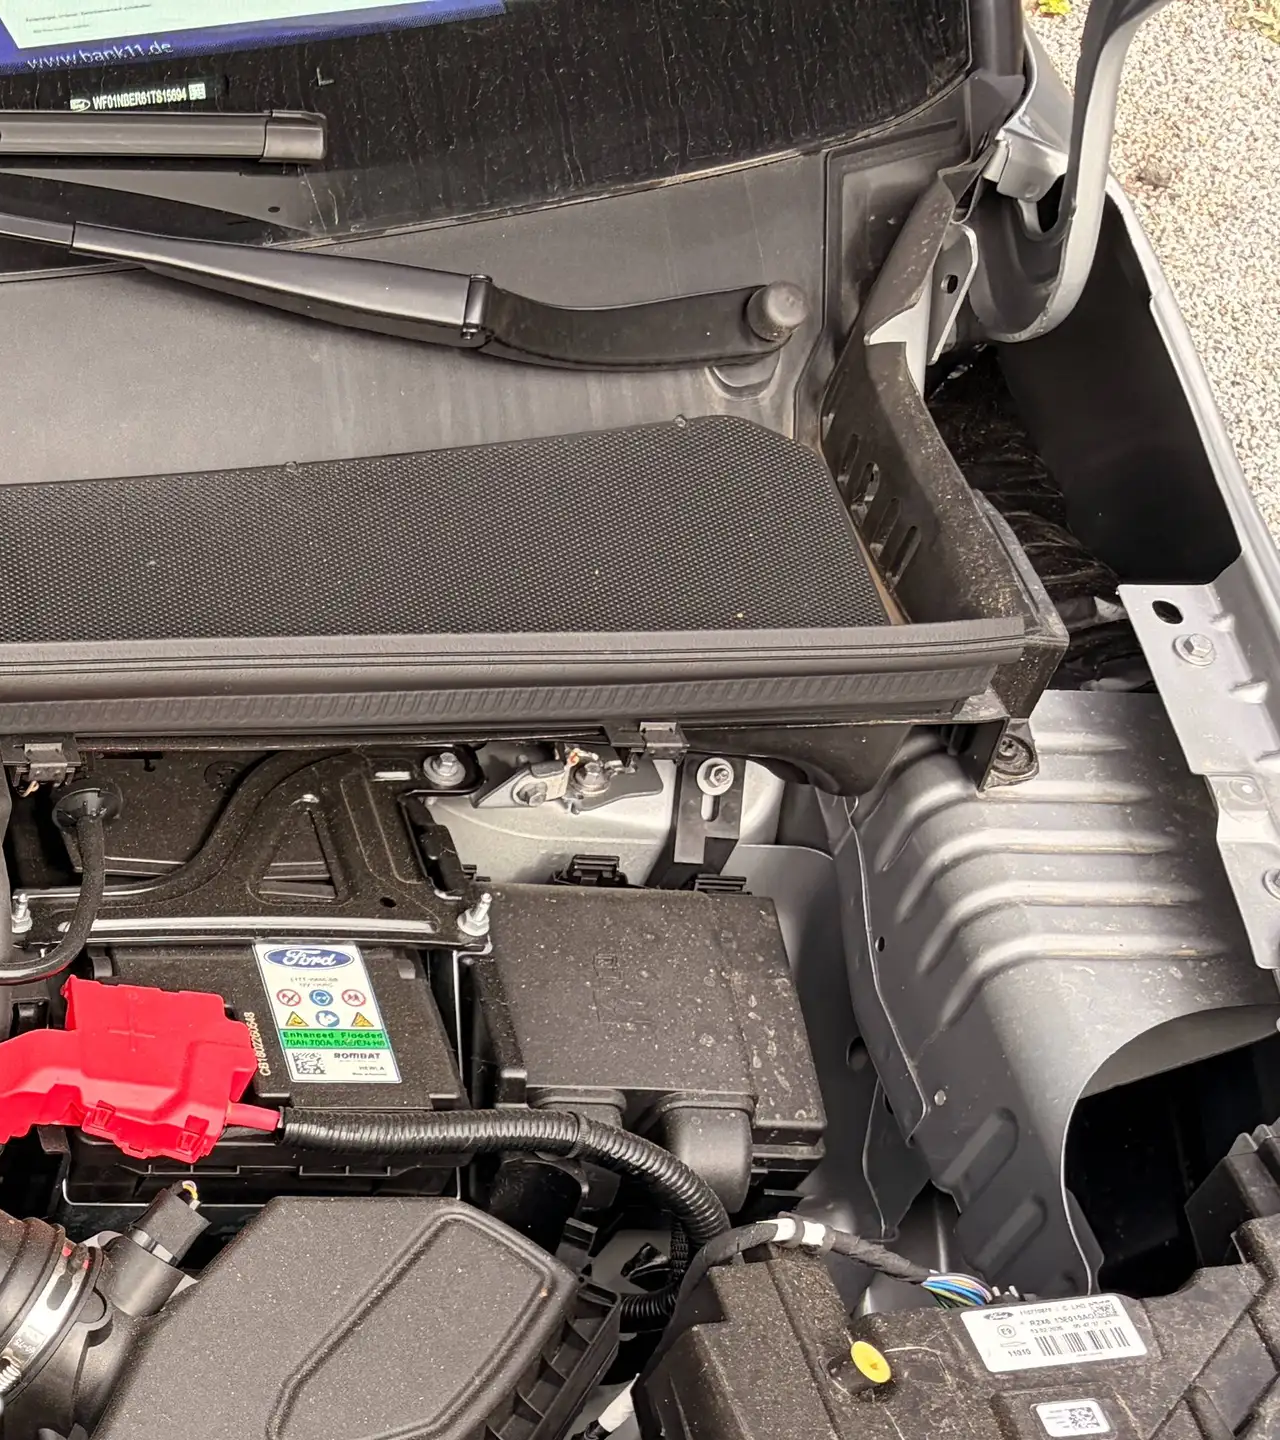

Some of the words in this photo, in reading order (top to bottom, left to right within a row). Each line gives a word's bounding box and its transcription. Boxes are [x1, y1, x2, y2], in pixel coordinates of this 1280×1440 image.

[26, 40, 174, 70] www.bank11.de
[282, 949, 337, 967] Ford
[283, 1031, 334, 1039] Enhanced
[341, 1031, 384, 1039] Flooded
